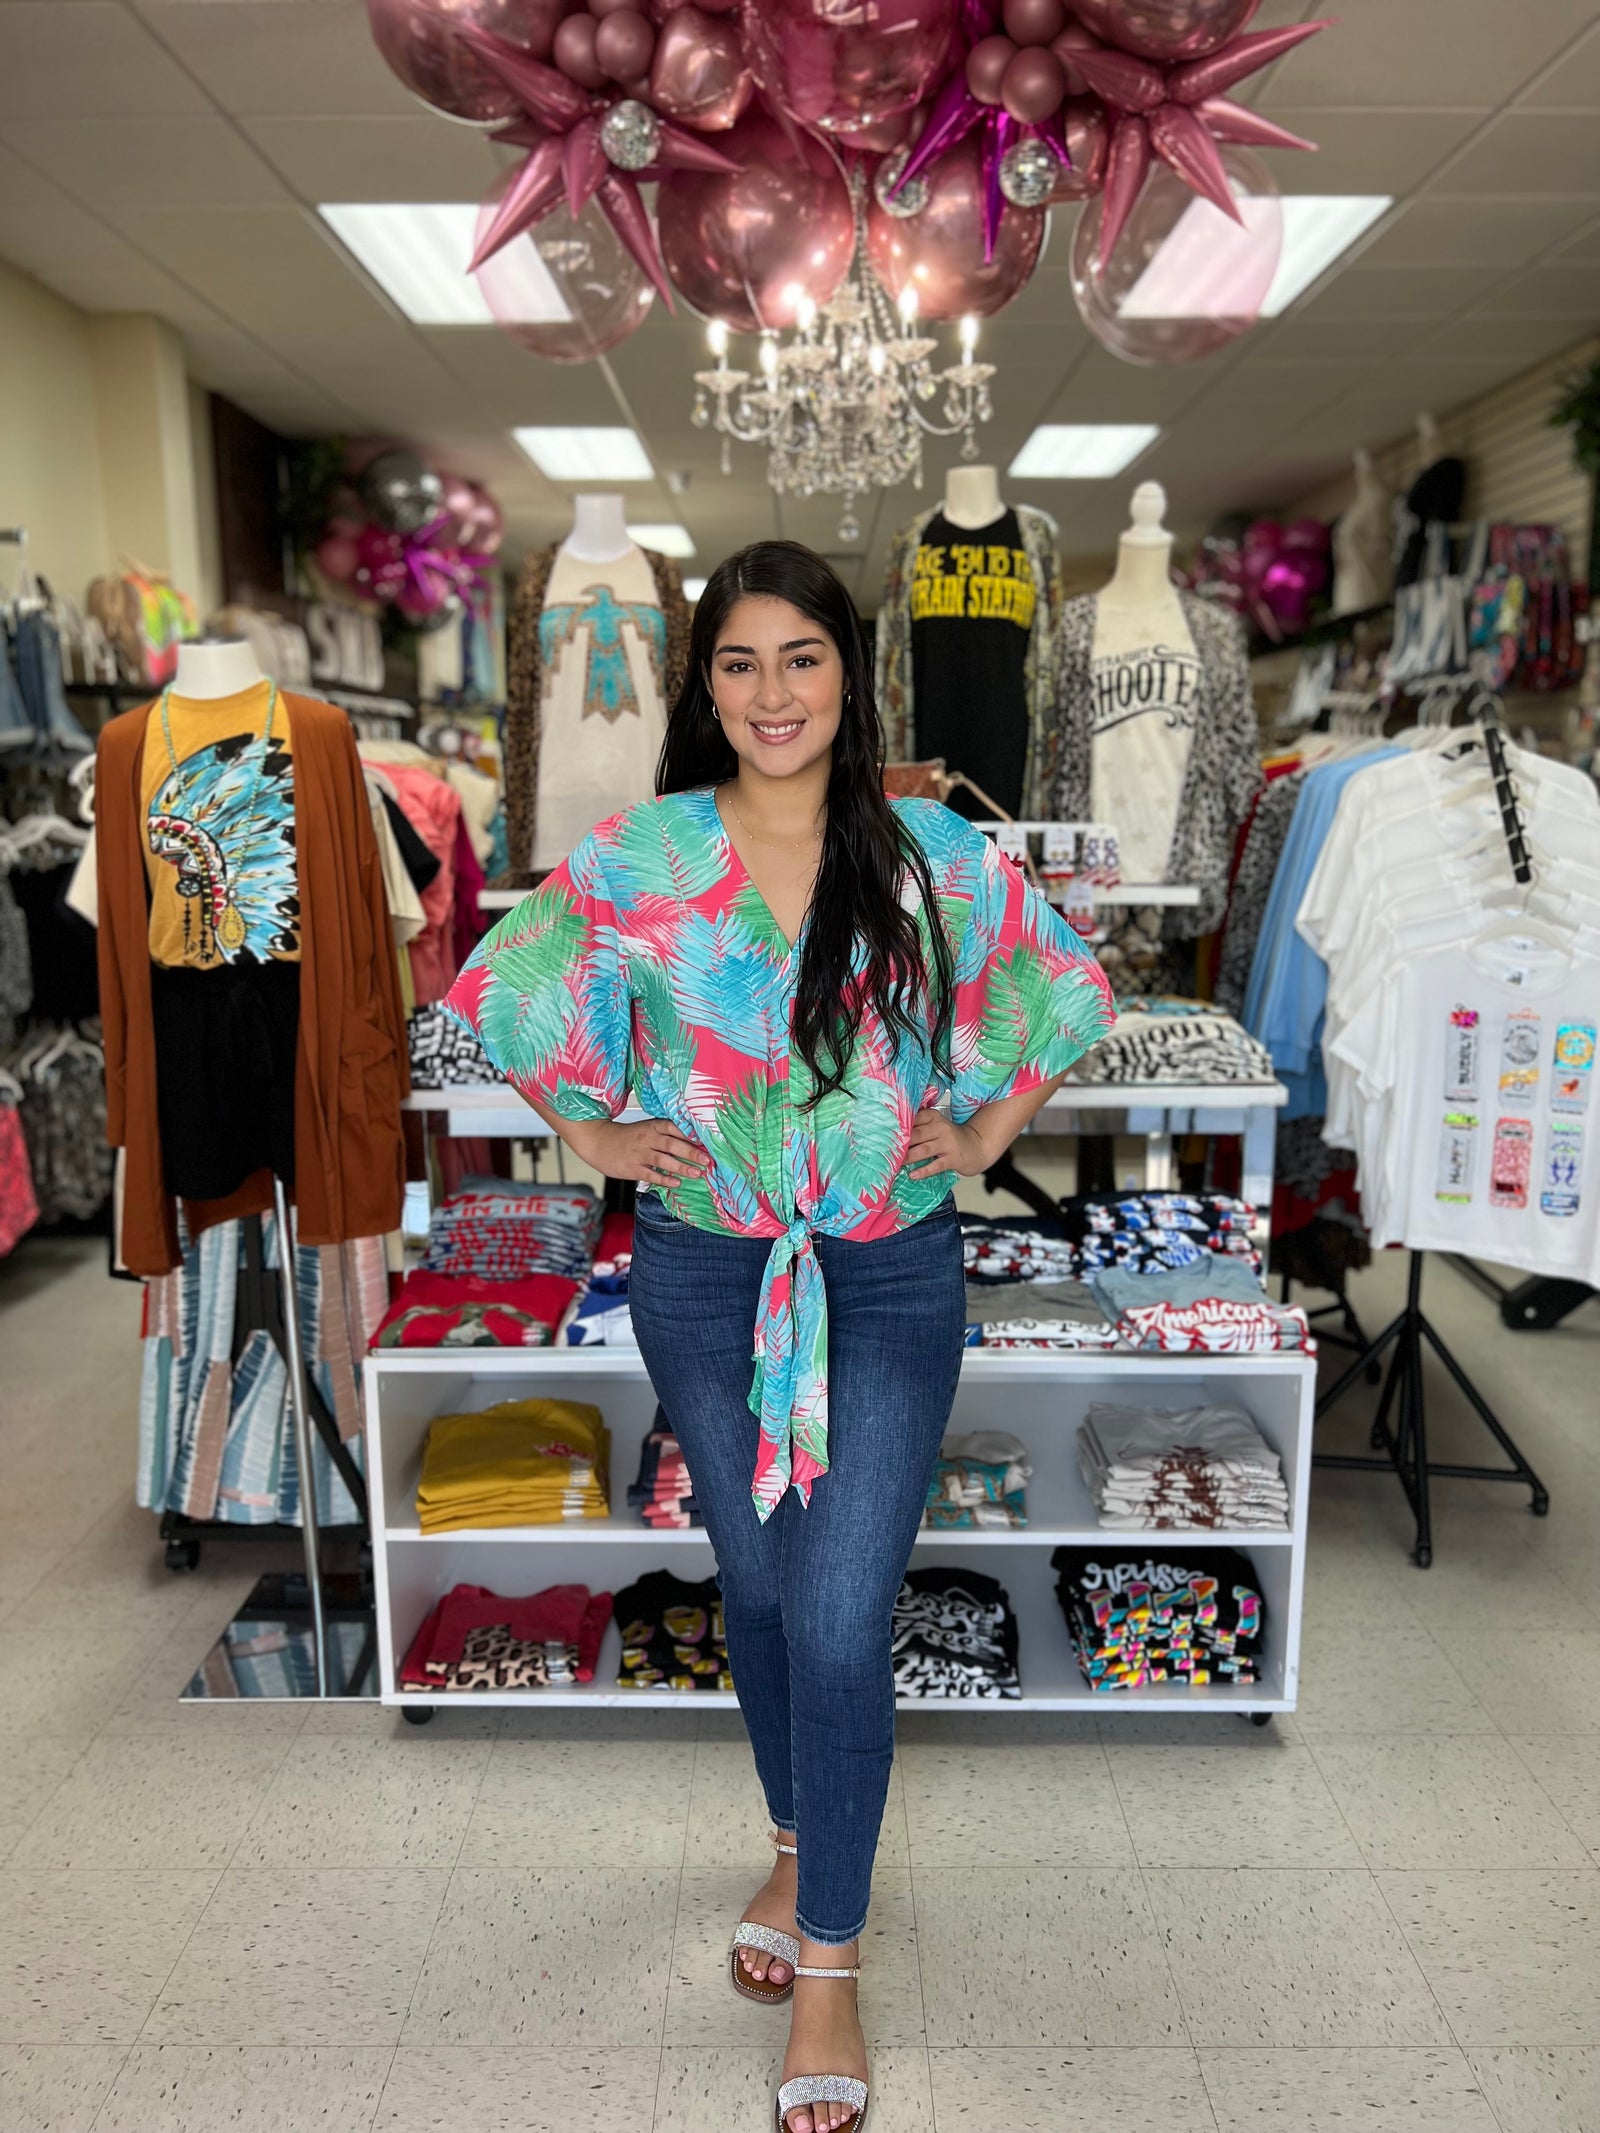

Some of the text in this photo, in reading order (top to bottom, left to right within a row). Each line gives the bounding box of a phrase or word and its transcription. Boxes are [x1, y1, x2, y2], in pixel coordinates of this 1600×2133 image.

[461, 1205, 491, 1218] IN
[503, 1199, 549, 1215] THE
[1124, 1297, 1273, 1338] American
[1081, 1559, 1205, 1595] raise
